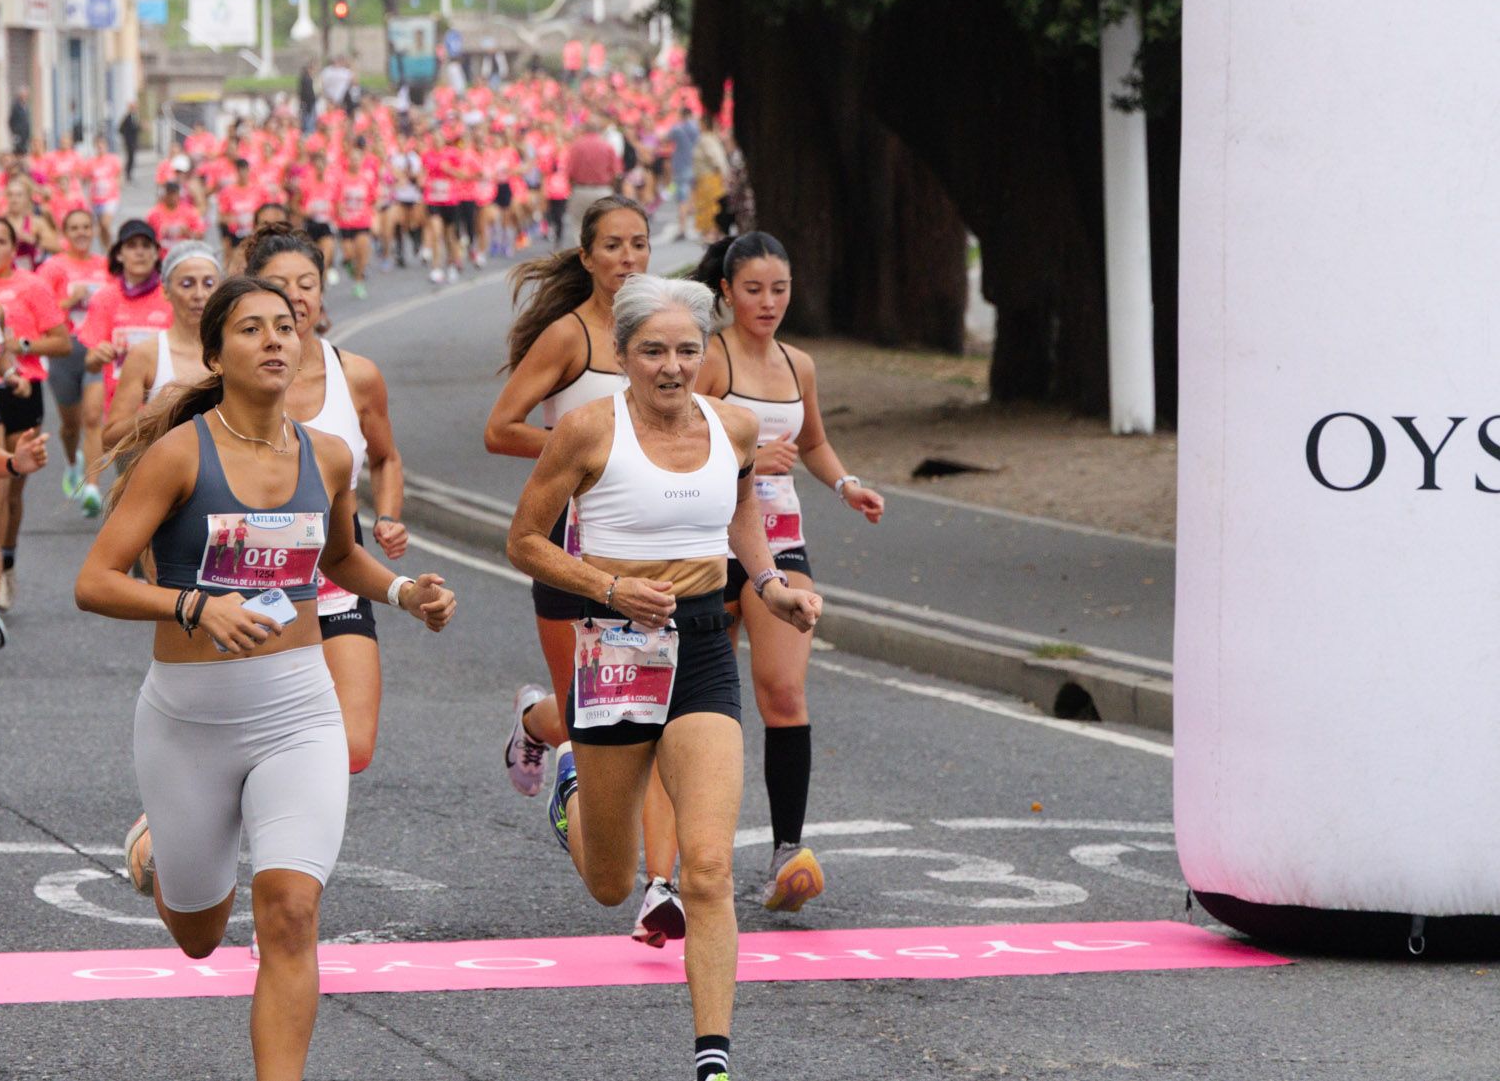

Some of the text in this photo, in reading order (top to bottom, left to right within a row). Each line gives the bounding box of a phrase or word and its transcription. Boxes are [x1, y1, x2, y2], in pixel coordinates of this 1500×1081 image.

[664, 490, 700, 499] OYSHO
[249, 512, 291, 523] ASTURIANA
[244, 548, 289, 567] 016
[211, 575, 239, 585] CARRERA
[240, 578, 248, 586] DE
[328, 613, 363, 623] OYSHO
[601, 665, 638, 684] 016
